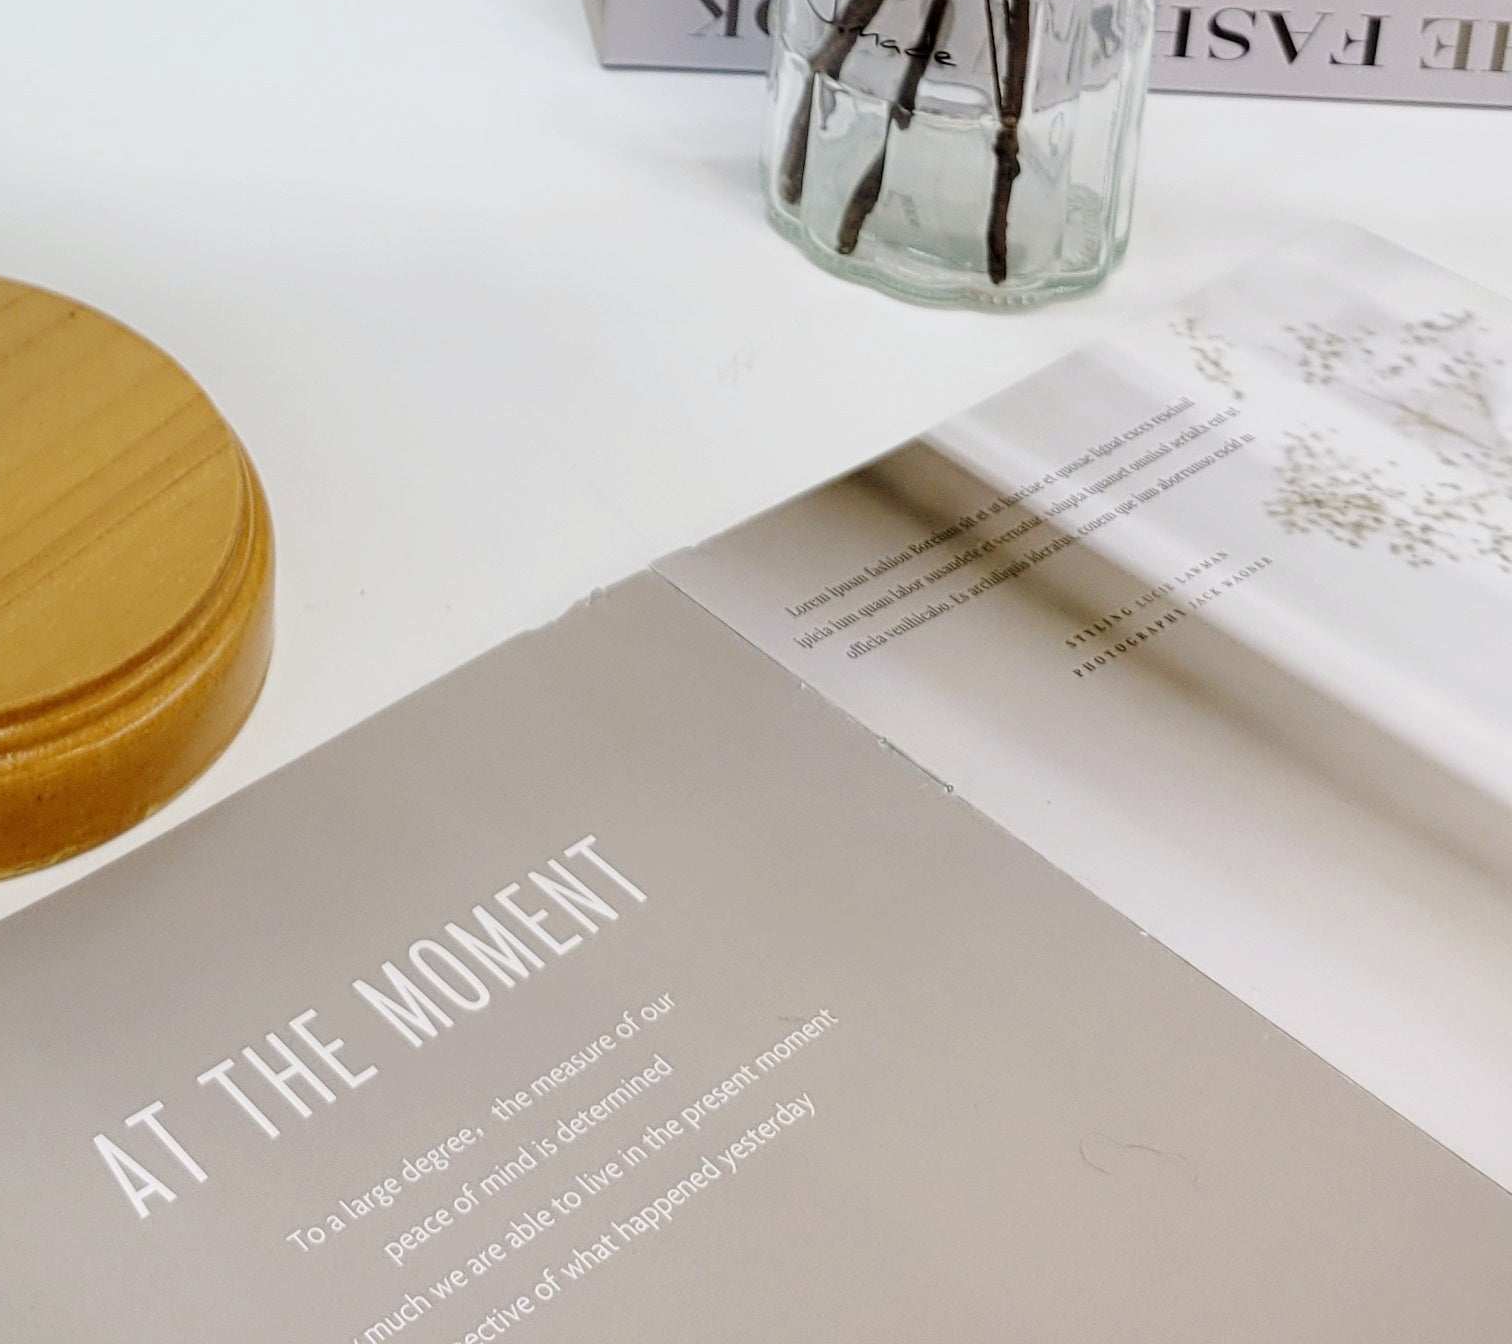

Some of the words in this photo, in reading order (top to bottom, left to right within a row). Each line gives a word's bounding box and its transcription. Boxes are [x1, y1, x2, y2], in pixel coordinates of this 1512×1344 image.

[784, 585, 831, 617] Lorem
[1065, 607, 1133, 649] STYLING
[1135, 582, 1176, 608] LUCIE
[1072, 607, 1187, 678] PHOTOGRAPHY
[1188, 586, 1222, 610] JACK
[93, 1099, 208, 1220] AT
[197, 1008, 378, 1139] THE
[352, 834, 648, 1048] MOMENT
[286, 1226, 326, 1252] To
[326, 1214, 347, 1233] a
[339, 1177, 402, 1219] large
[402, 1127, 484, 1182] degree,
[491, 1089, 533, 1121] the
[531, 1033, 617, 1097] measure
[616, 1010, 641, 1040] of
[641, 992, 676, 1022] our
[364, 1293, 433, 1344] much
[429, 1269, 469, 1300] we
[466, 1242, 507, 1275] are
[504, 1209, 556, 1248] able
[551, 1190, 583, 1215] to
[575, 1162, 624, 1196] live
[617, 1143, 649, 1168] in
[642, 1118, 684, 1152] the
[681, 1063, 760, 1130] present
[754, 1008, 840, 1073] moment
[384, 1208, 454, 1267] peace
[453, 1182, 480, 1214] of
[479, 1146, 538, 1196] mind
[531, 1137, 558, 1158] is
[556, 1053, 674, 1144] determined
[451, 1296, 536, 1344] ective
[534, 1268, 562, 1301] of
[560, 1233, 621, 1280] what
[610, 1156, 722, 1242] happened
[717, 1091, 817, 1174] yesterday
